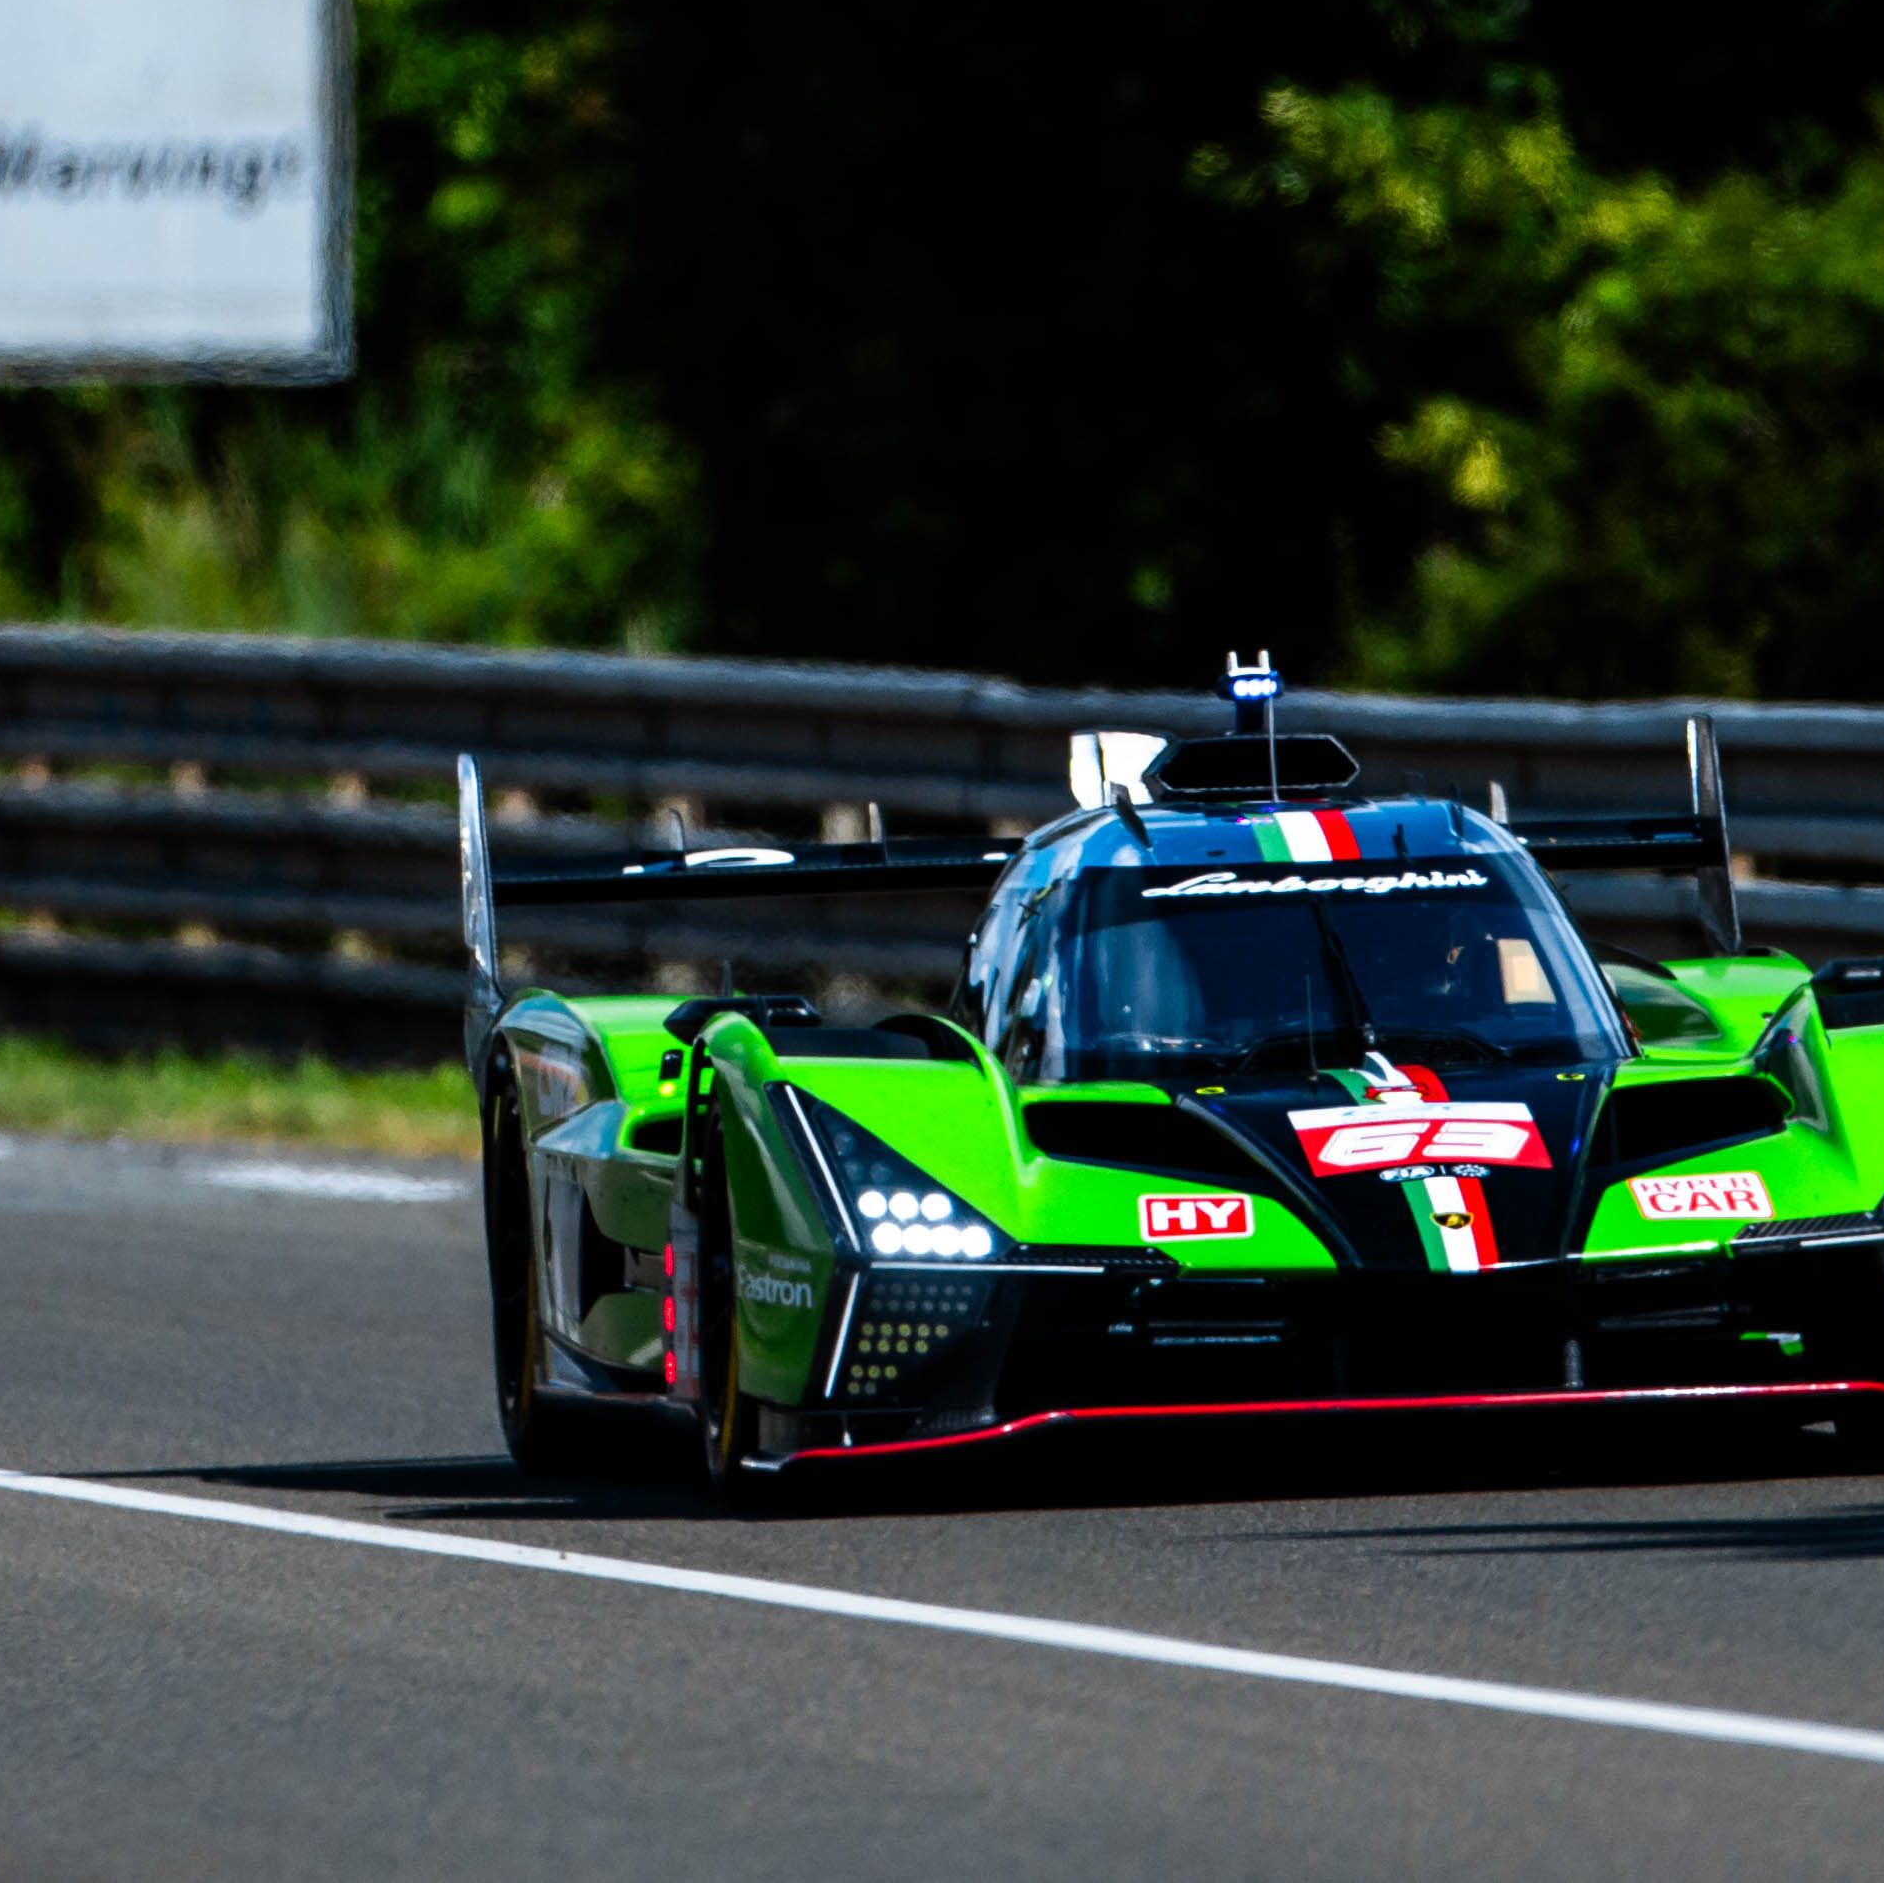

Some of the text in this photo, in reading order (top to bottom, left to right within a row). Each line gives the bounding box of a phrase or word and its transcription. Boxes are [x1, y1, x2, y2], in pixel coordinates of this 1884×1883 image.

[1142, 870, 1488, 897] Lamborghini
[1319, 1121, 1530, 1166] 63
[1150, 1200, 1241, 1231] HY
[1649, 1190, 1760, 1213] CAR
